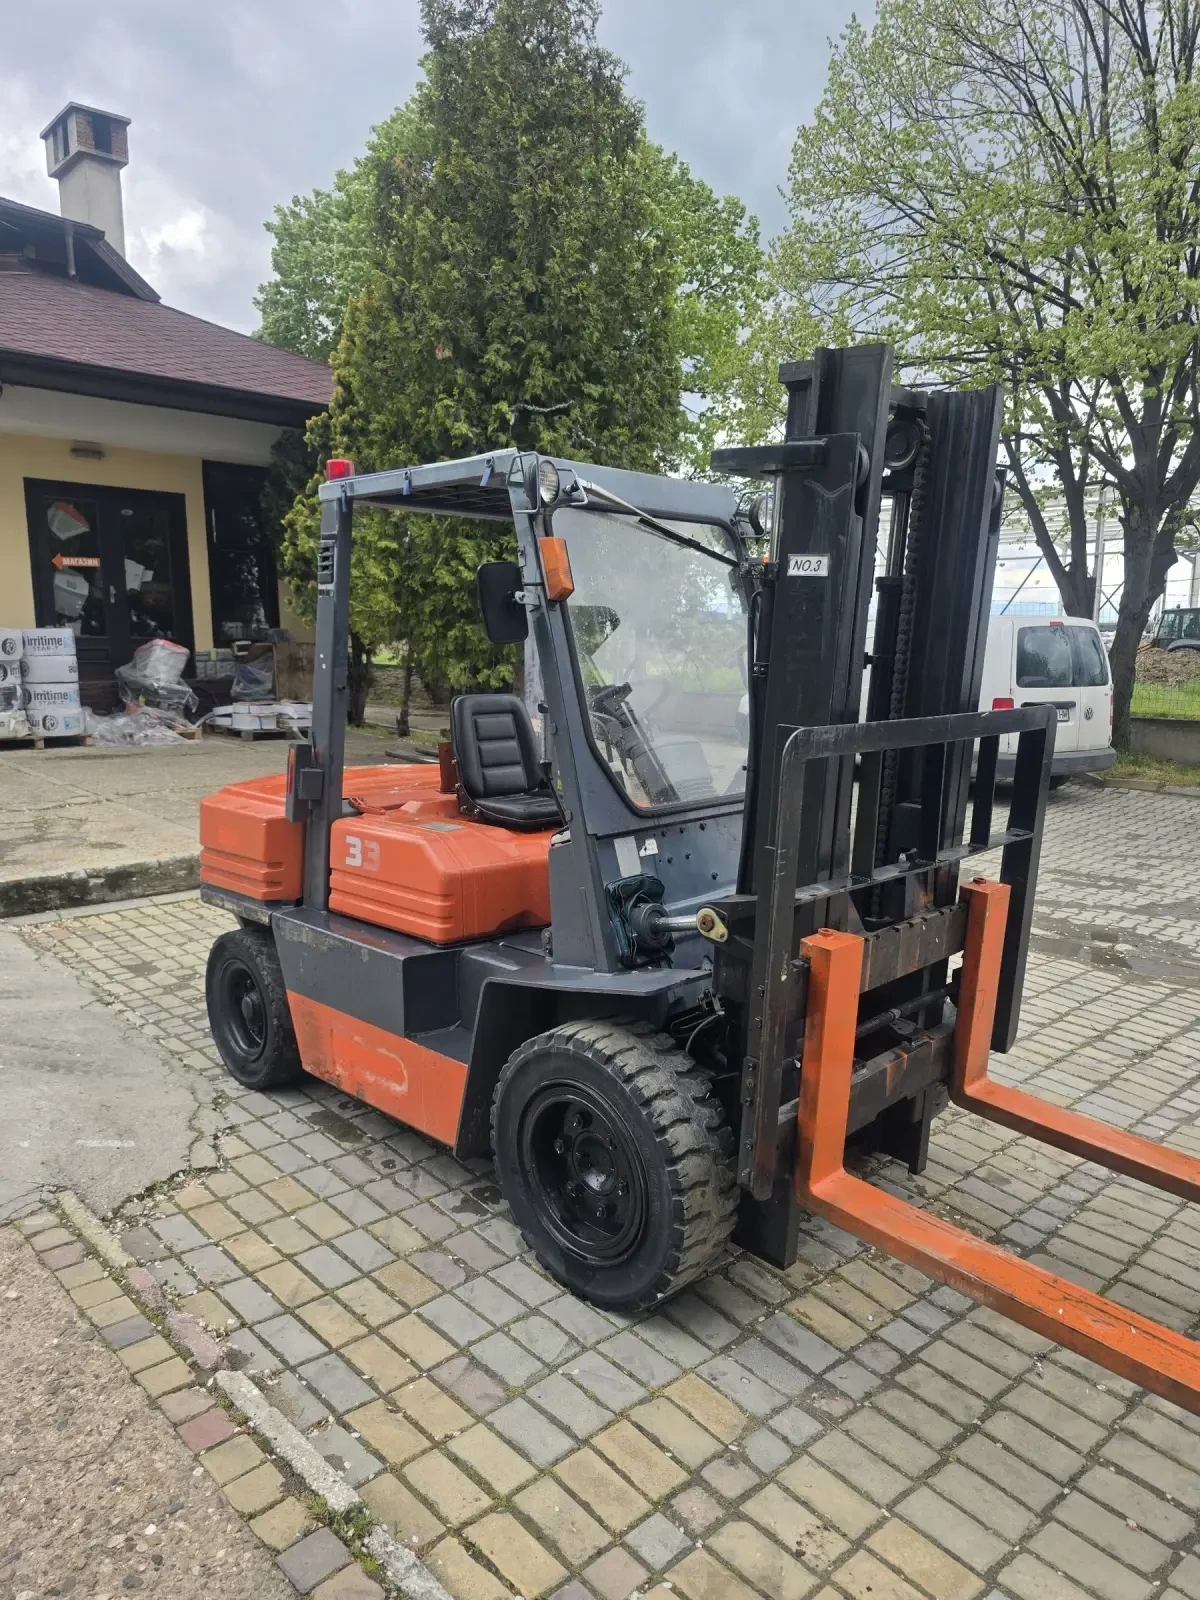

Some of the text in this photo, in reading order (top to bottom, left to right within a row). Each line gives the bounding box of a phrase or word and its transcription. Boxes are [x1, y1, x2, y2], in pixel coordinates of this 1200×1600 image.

[62, 557, 98, 567] МАГАЗИН
[793, 560, 822, 572] NO.3
[27, 635, 63, 646] irritime
[33, 690, 69, 701] irritime
